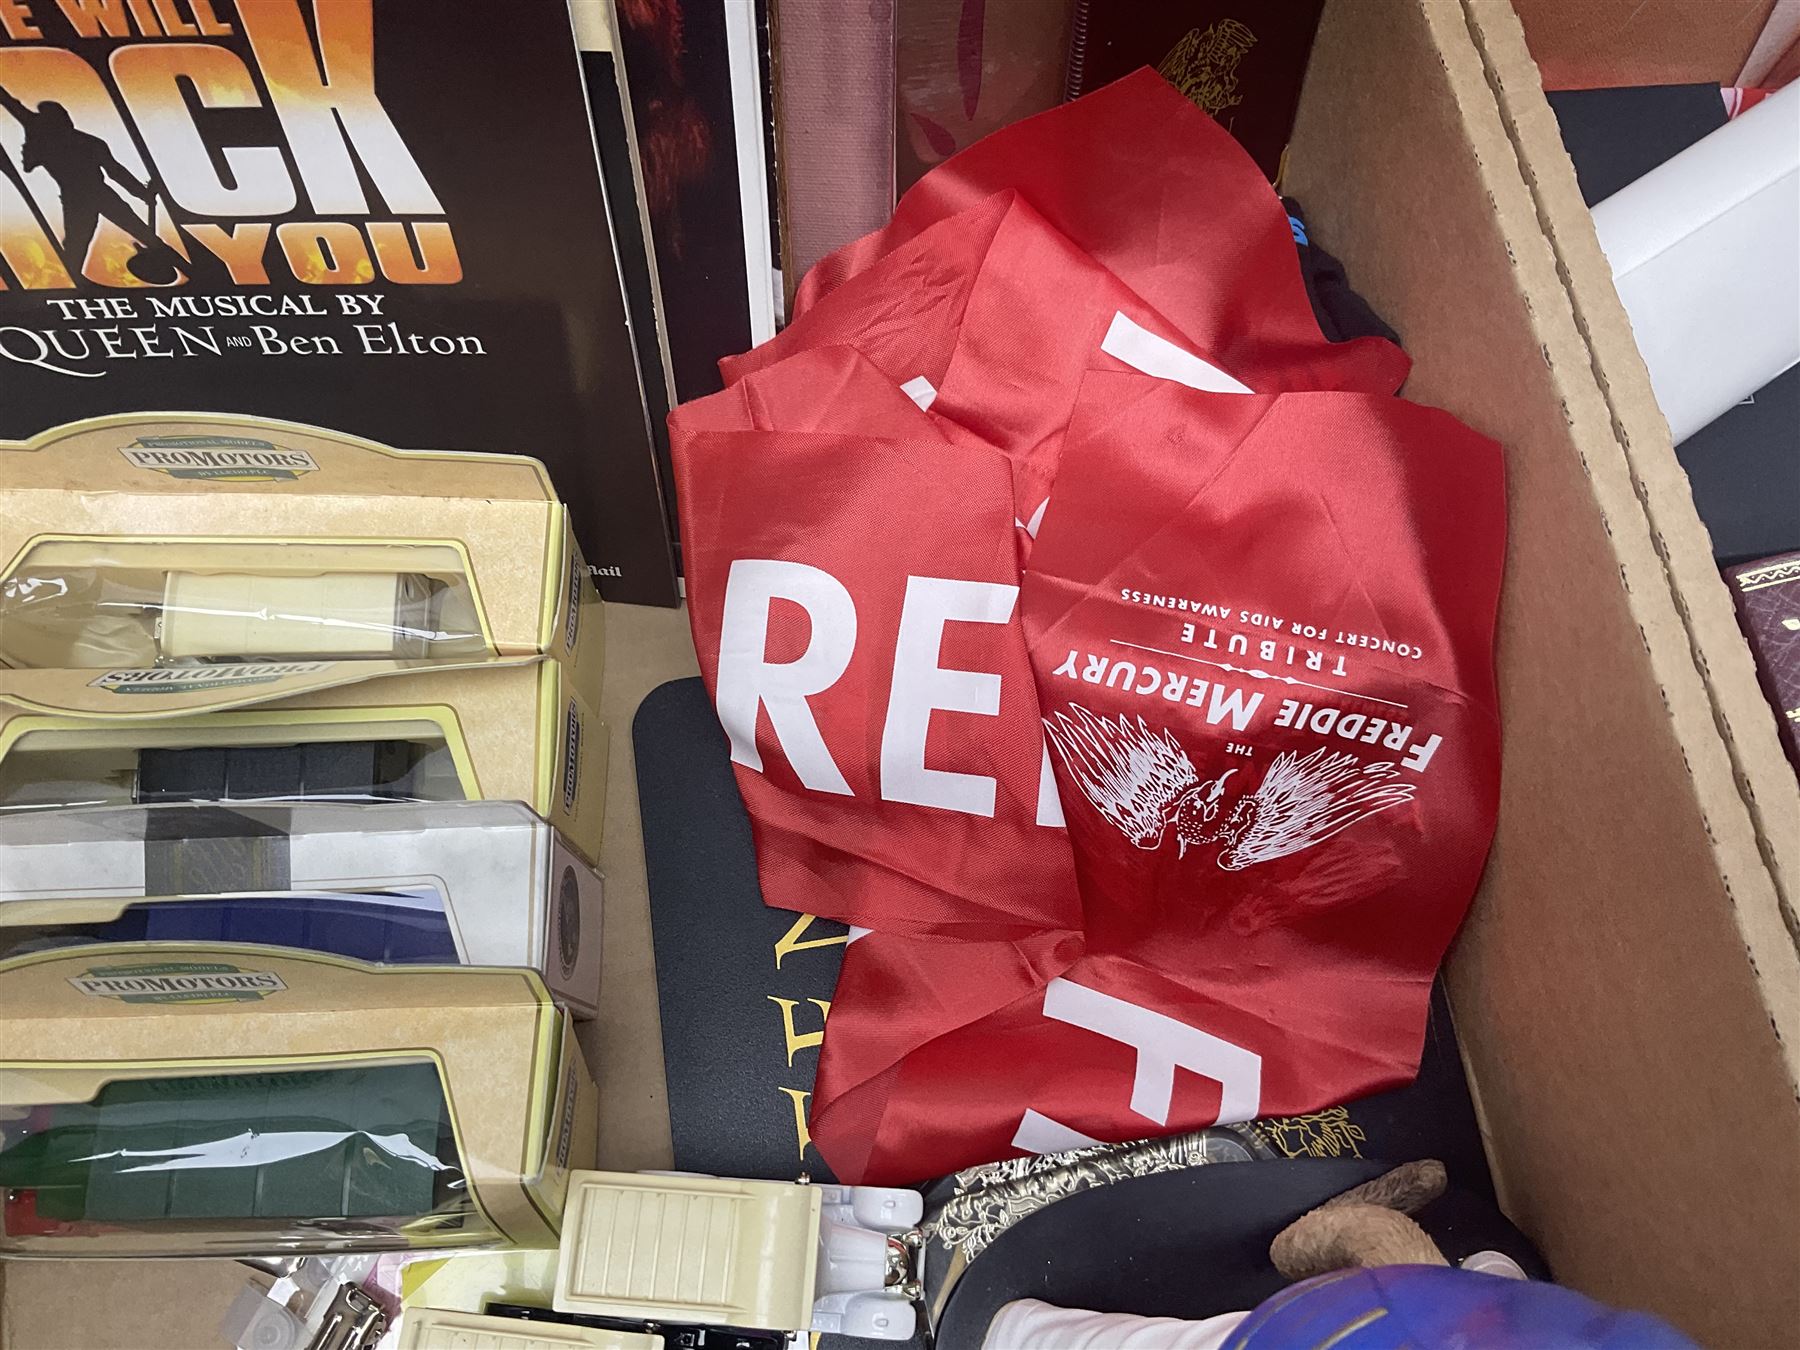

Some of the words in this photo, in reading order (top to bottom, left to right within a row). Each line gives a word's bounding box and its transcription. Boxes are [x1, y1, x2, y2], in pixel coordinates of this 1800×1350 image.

[0, 0, 44, 39] E
[55, 0, 234, 38] WILL
[0, 0, 446, 289] OCK
[181, 222, 463, 286] YOU
[47, 298, 138, 320] THE
[146, 294, 327, 318] MUSICAL
[335, 294, 385, 315] BY
[0, 324, 222, 377] QUEEN
[226, 337, 251, 348] AND
[249, 325, 343, 355] Ben
[353, 321, 487, 355] Elton
[130, 451, 310, 467] PROMOTORS
[1120, 588, 1232, 620] AWARENESS
[1239, 610, 1283, 630] AIDS
[1291, 621, 1327, 640] FOR
[1335, 630, 1423, 660] CONCERT
[1180, 622, 1348, 677] TRIBUTE
[716, 558, 1067, 829] RE
[1052, 649, 1265, 732] MERCURY
[1225, 742, 1253, 757] THE
[1274, 698, 1443, 774] FREDDIE
[81, 974, 279, 992] PROMOTORS
